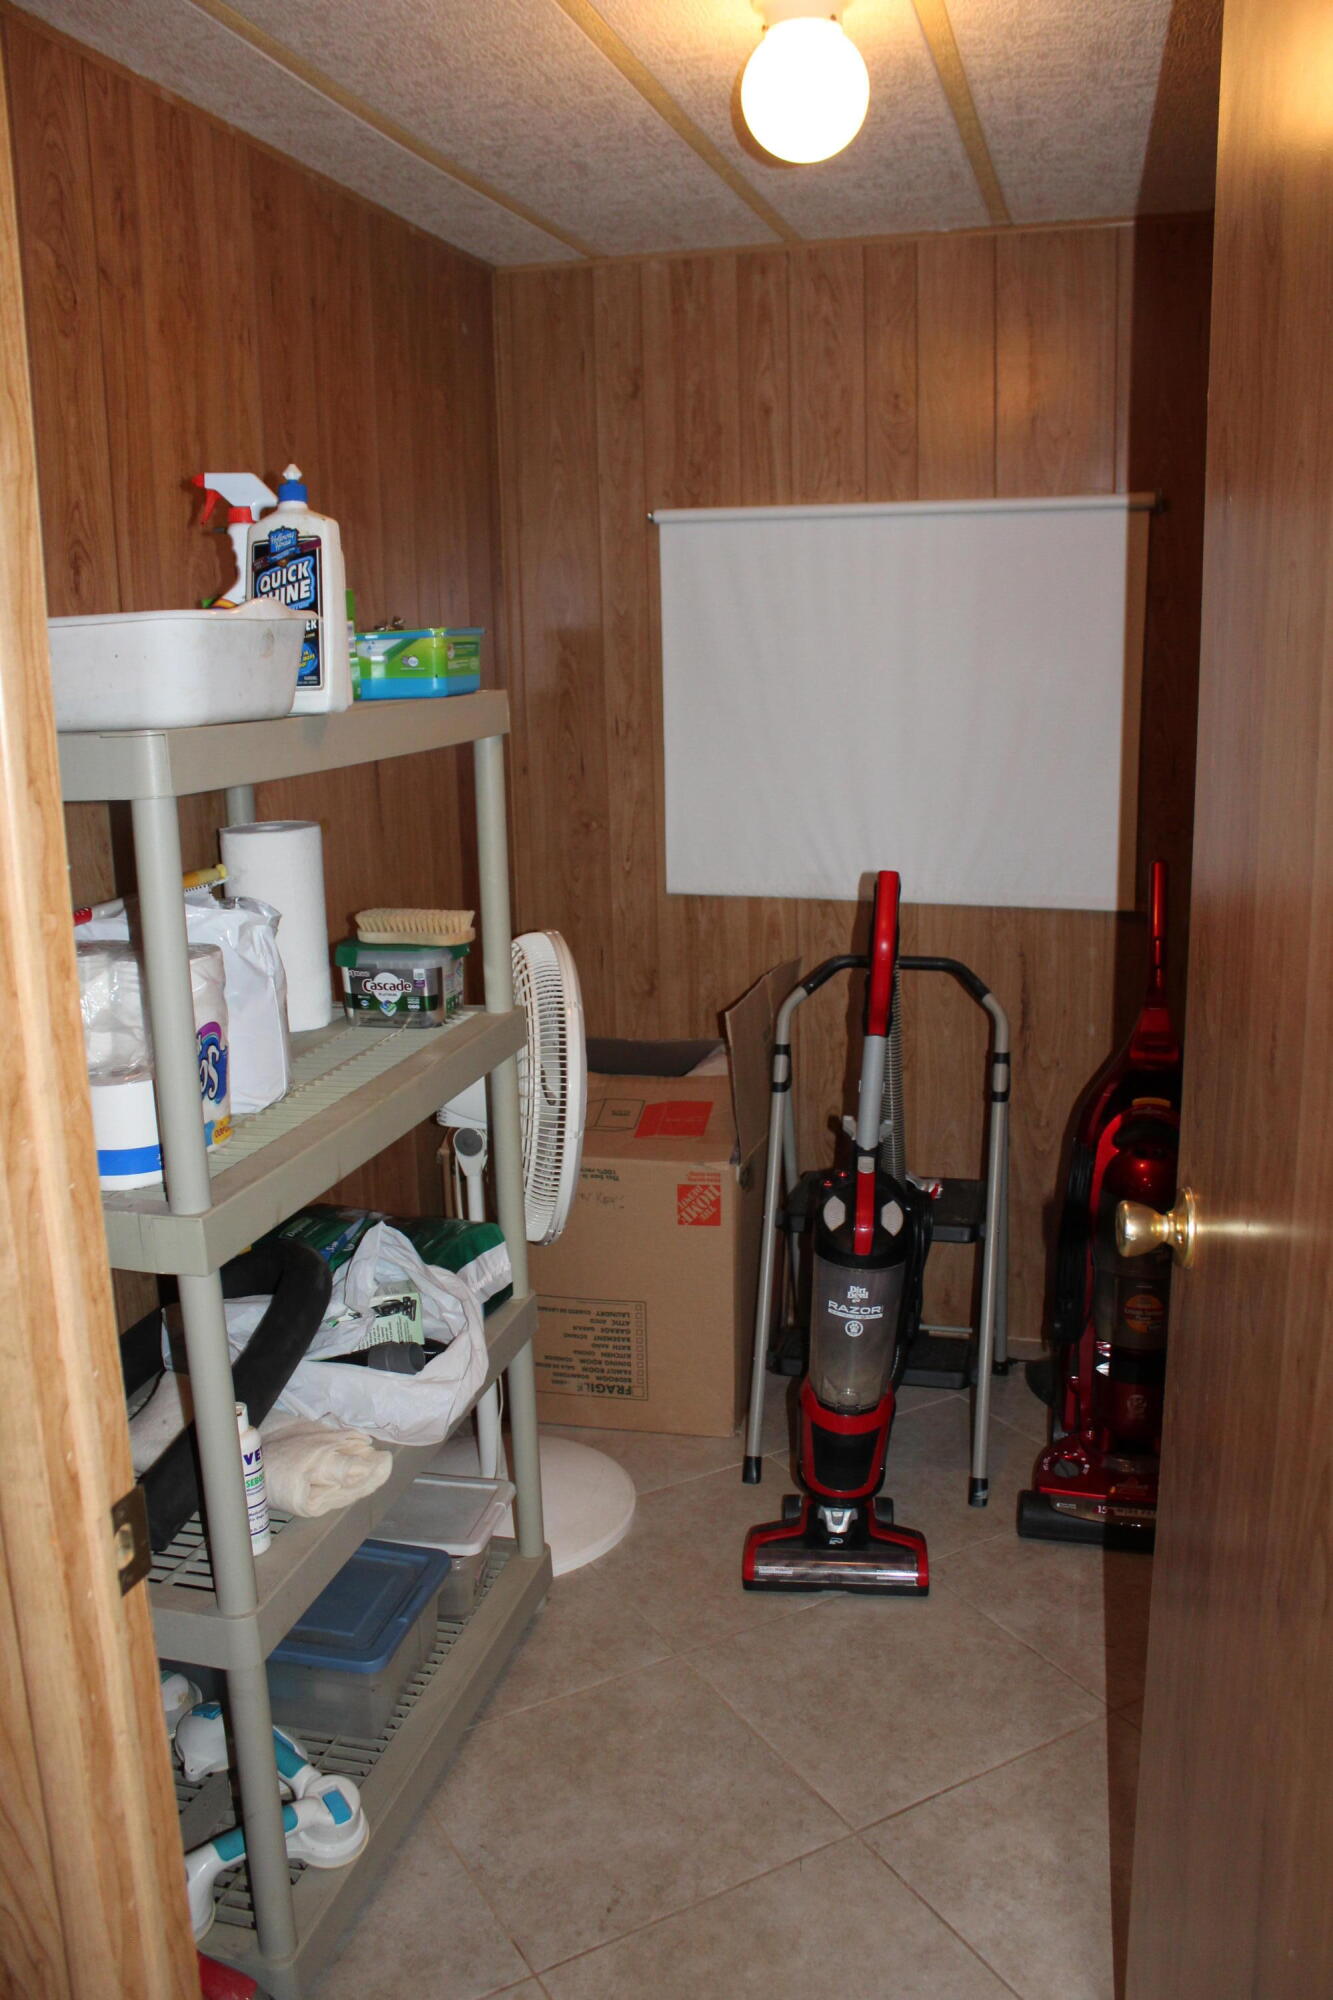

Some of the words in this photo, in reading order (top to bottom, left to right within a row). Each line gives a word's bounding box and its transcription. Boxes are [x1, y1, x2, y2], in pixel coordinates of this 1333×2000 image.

[260, 560, 309, 593] QUICK
[362, 978, 412, 993] Cascade
[681, 1185, 721, 1225] HOME
[847, 1291, 869, 1299] Devil
[849, 1285, 867, 1294] Dirt
[828, 1300, 882, 1315] RAZOR
